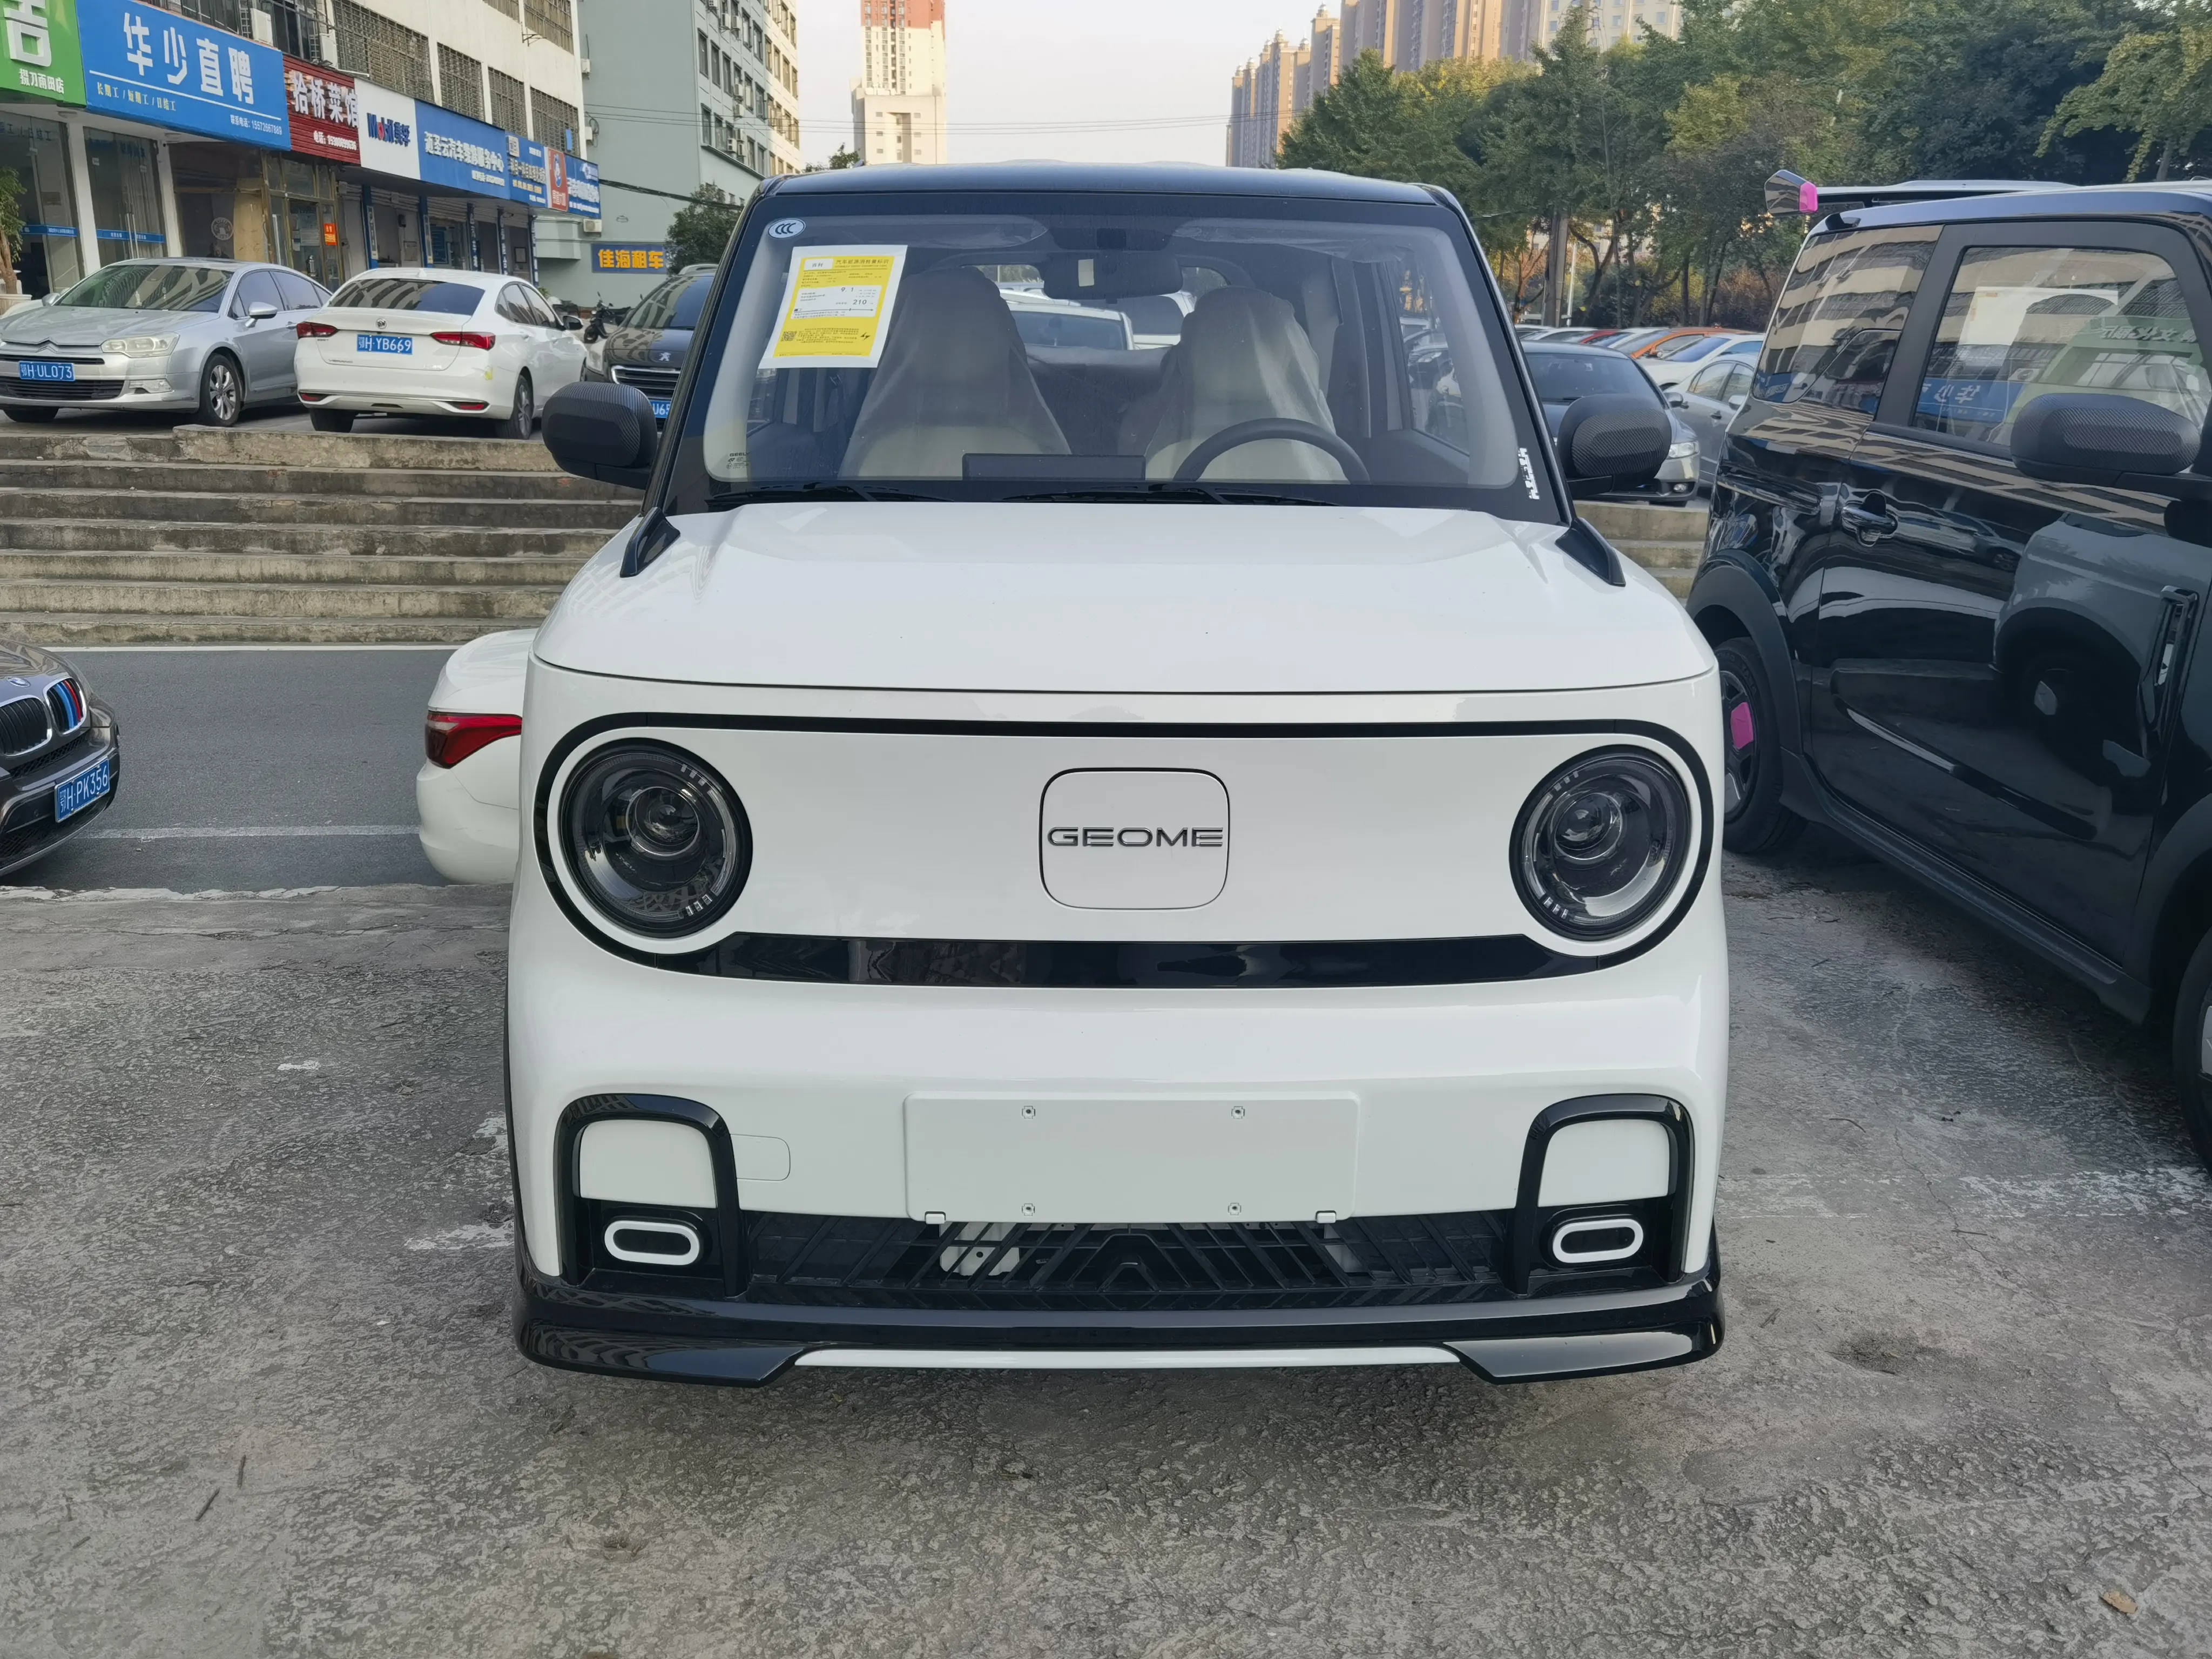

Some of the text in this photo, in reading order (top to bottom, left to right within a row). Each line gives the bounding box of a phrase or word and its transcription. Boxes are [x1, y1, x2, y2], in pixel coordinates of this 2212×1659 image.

[123, 12, 254, 104] 华少直聘
[292, 71, 360, 129] 拾桥菜馆
[367, 112, 394, 143] Mobil
[598, 249, 664, 269] 佳海租车
[1047, 826, 1224, 847] GEOME
